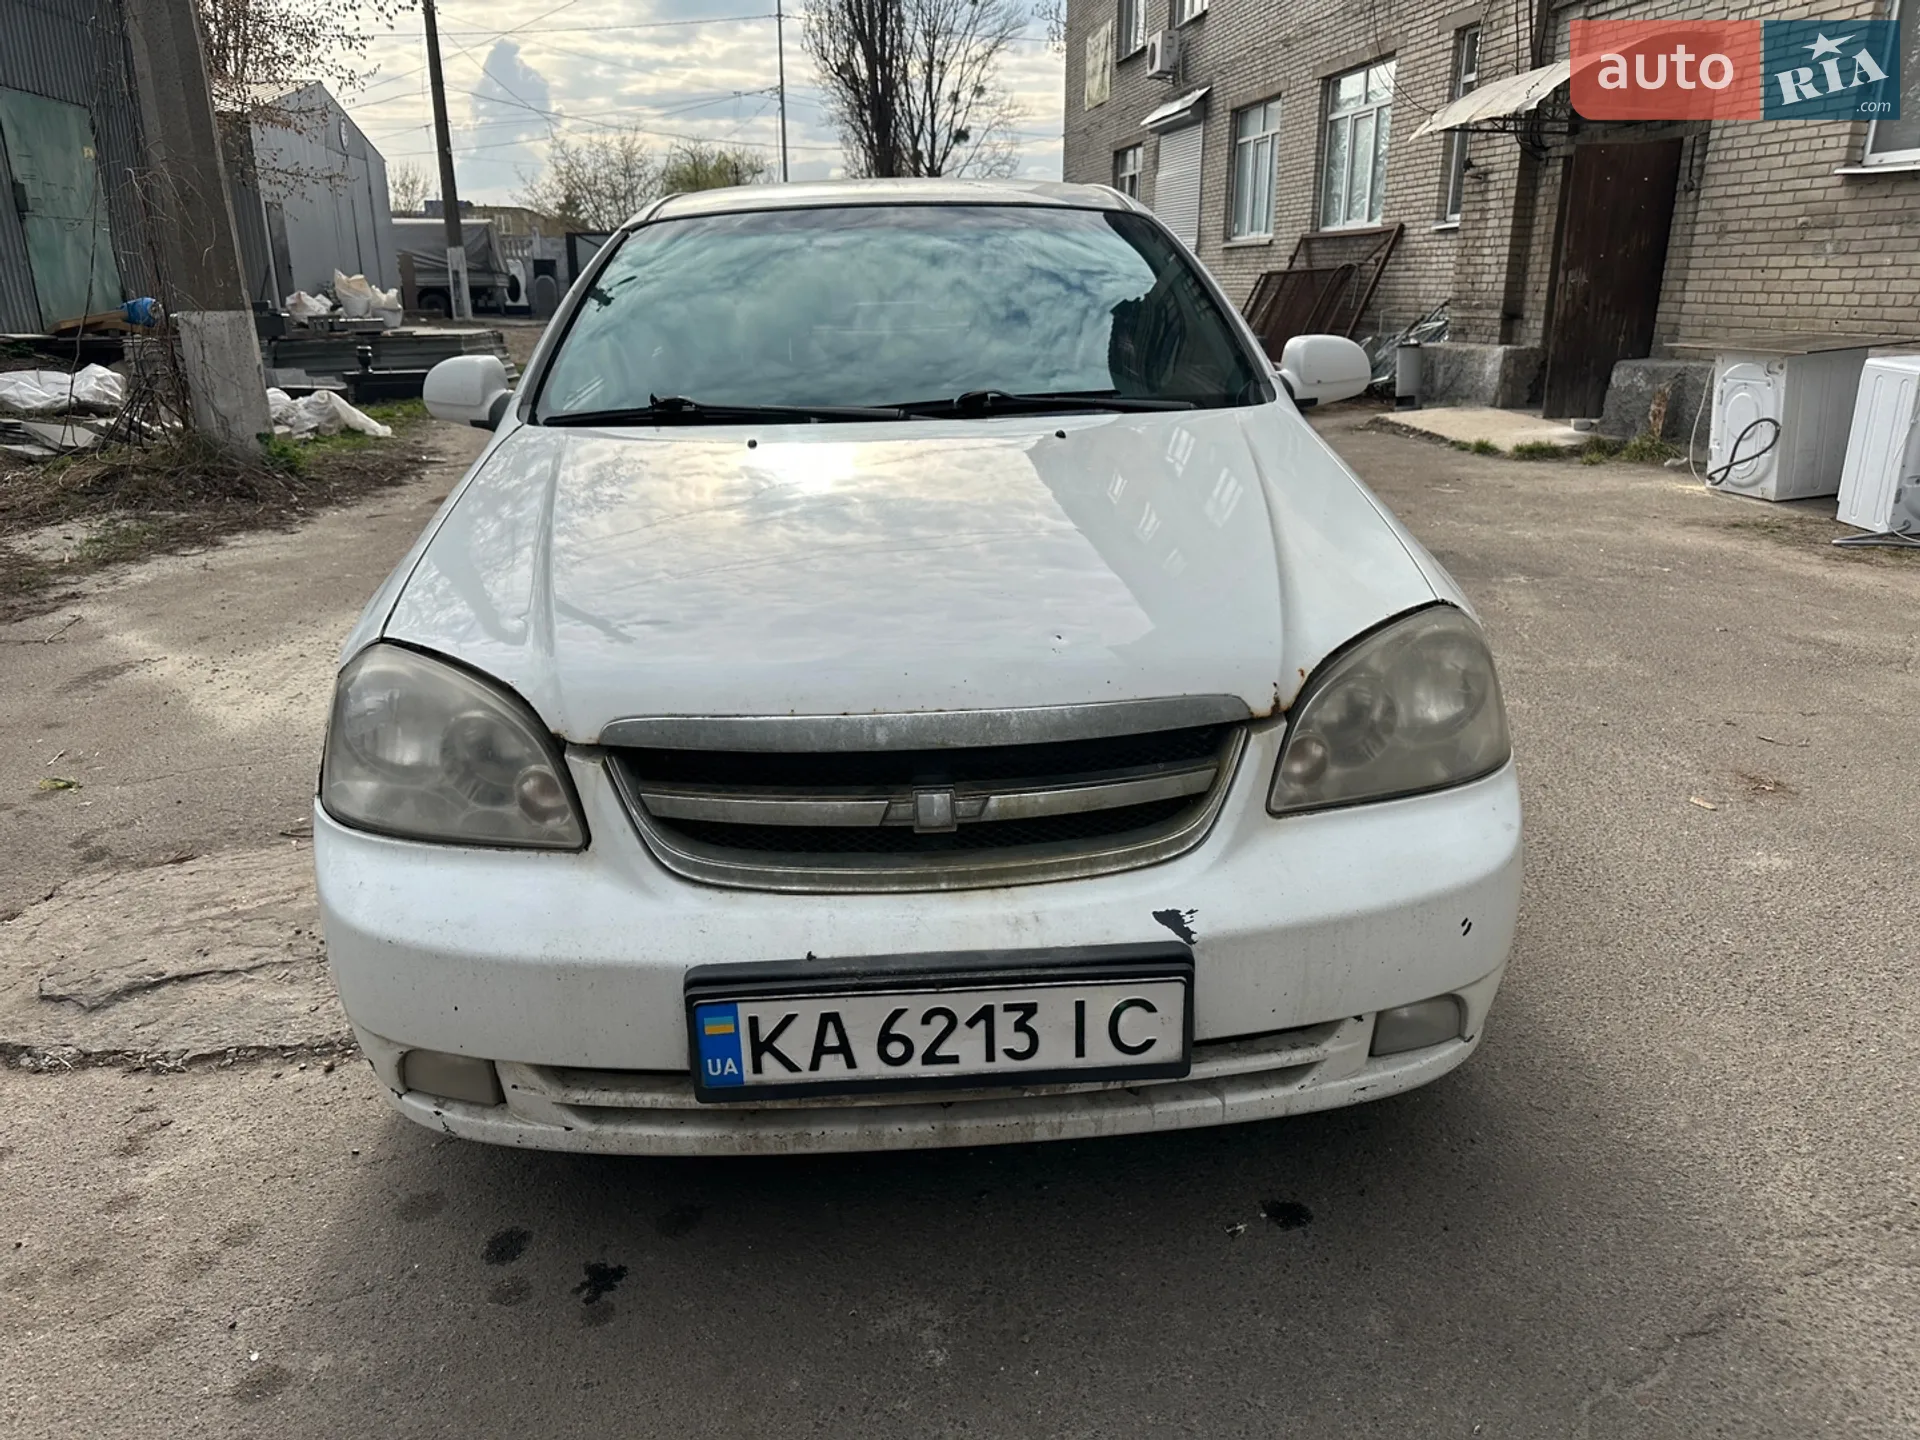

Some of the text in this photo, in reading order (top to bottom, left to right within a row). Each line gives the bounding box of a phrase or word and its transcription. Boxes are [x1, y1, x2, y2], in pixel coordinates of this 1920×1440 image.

[748, 998, 1159, 1074] KA 6213 IC
[707, 1057, 738, 1076] UA
